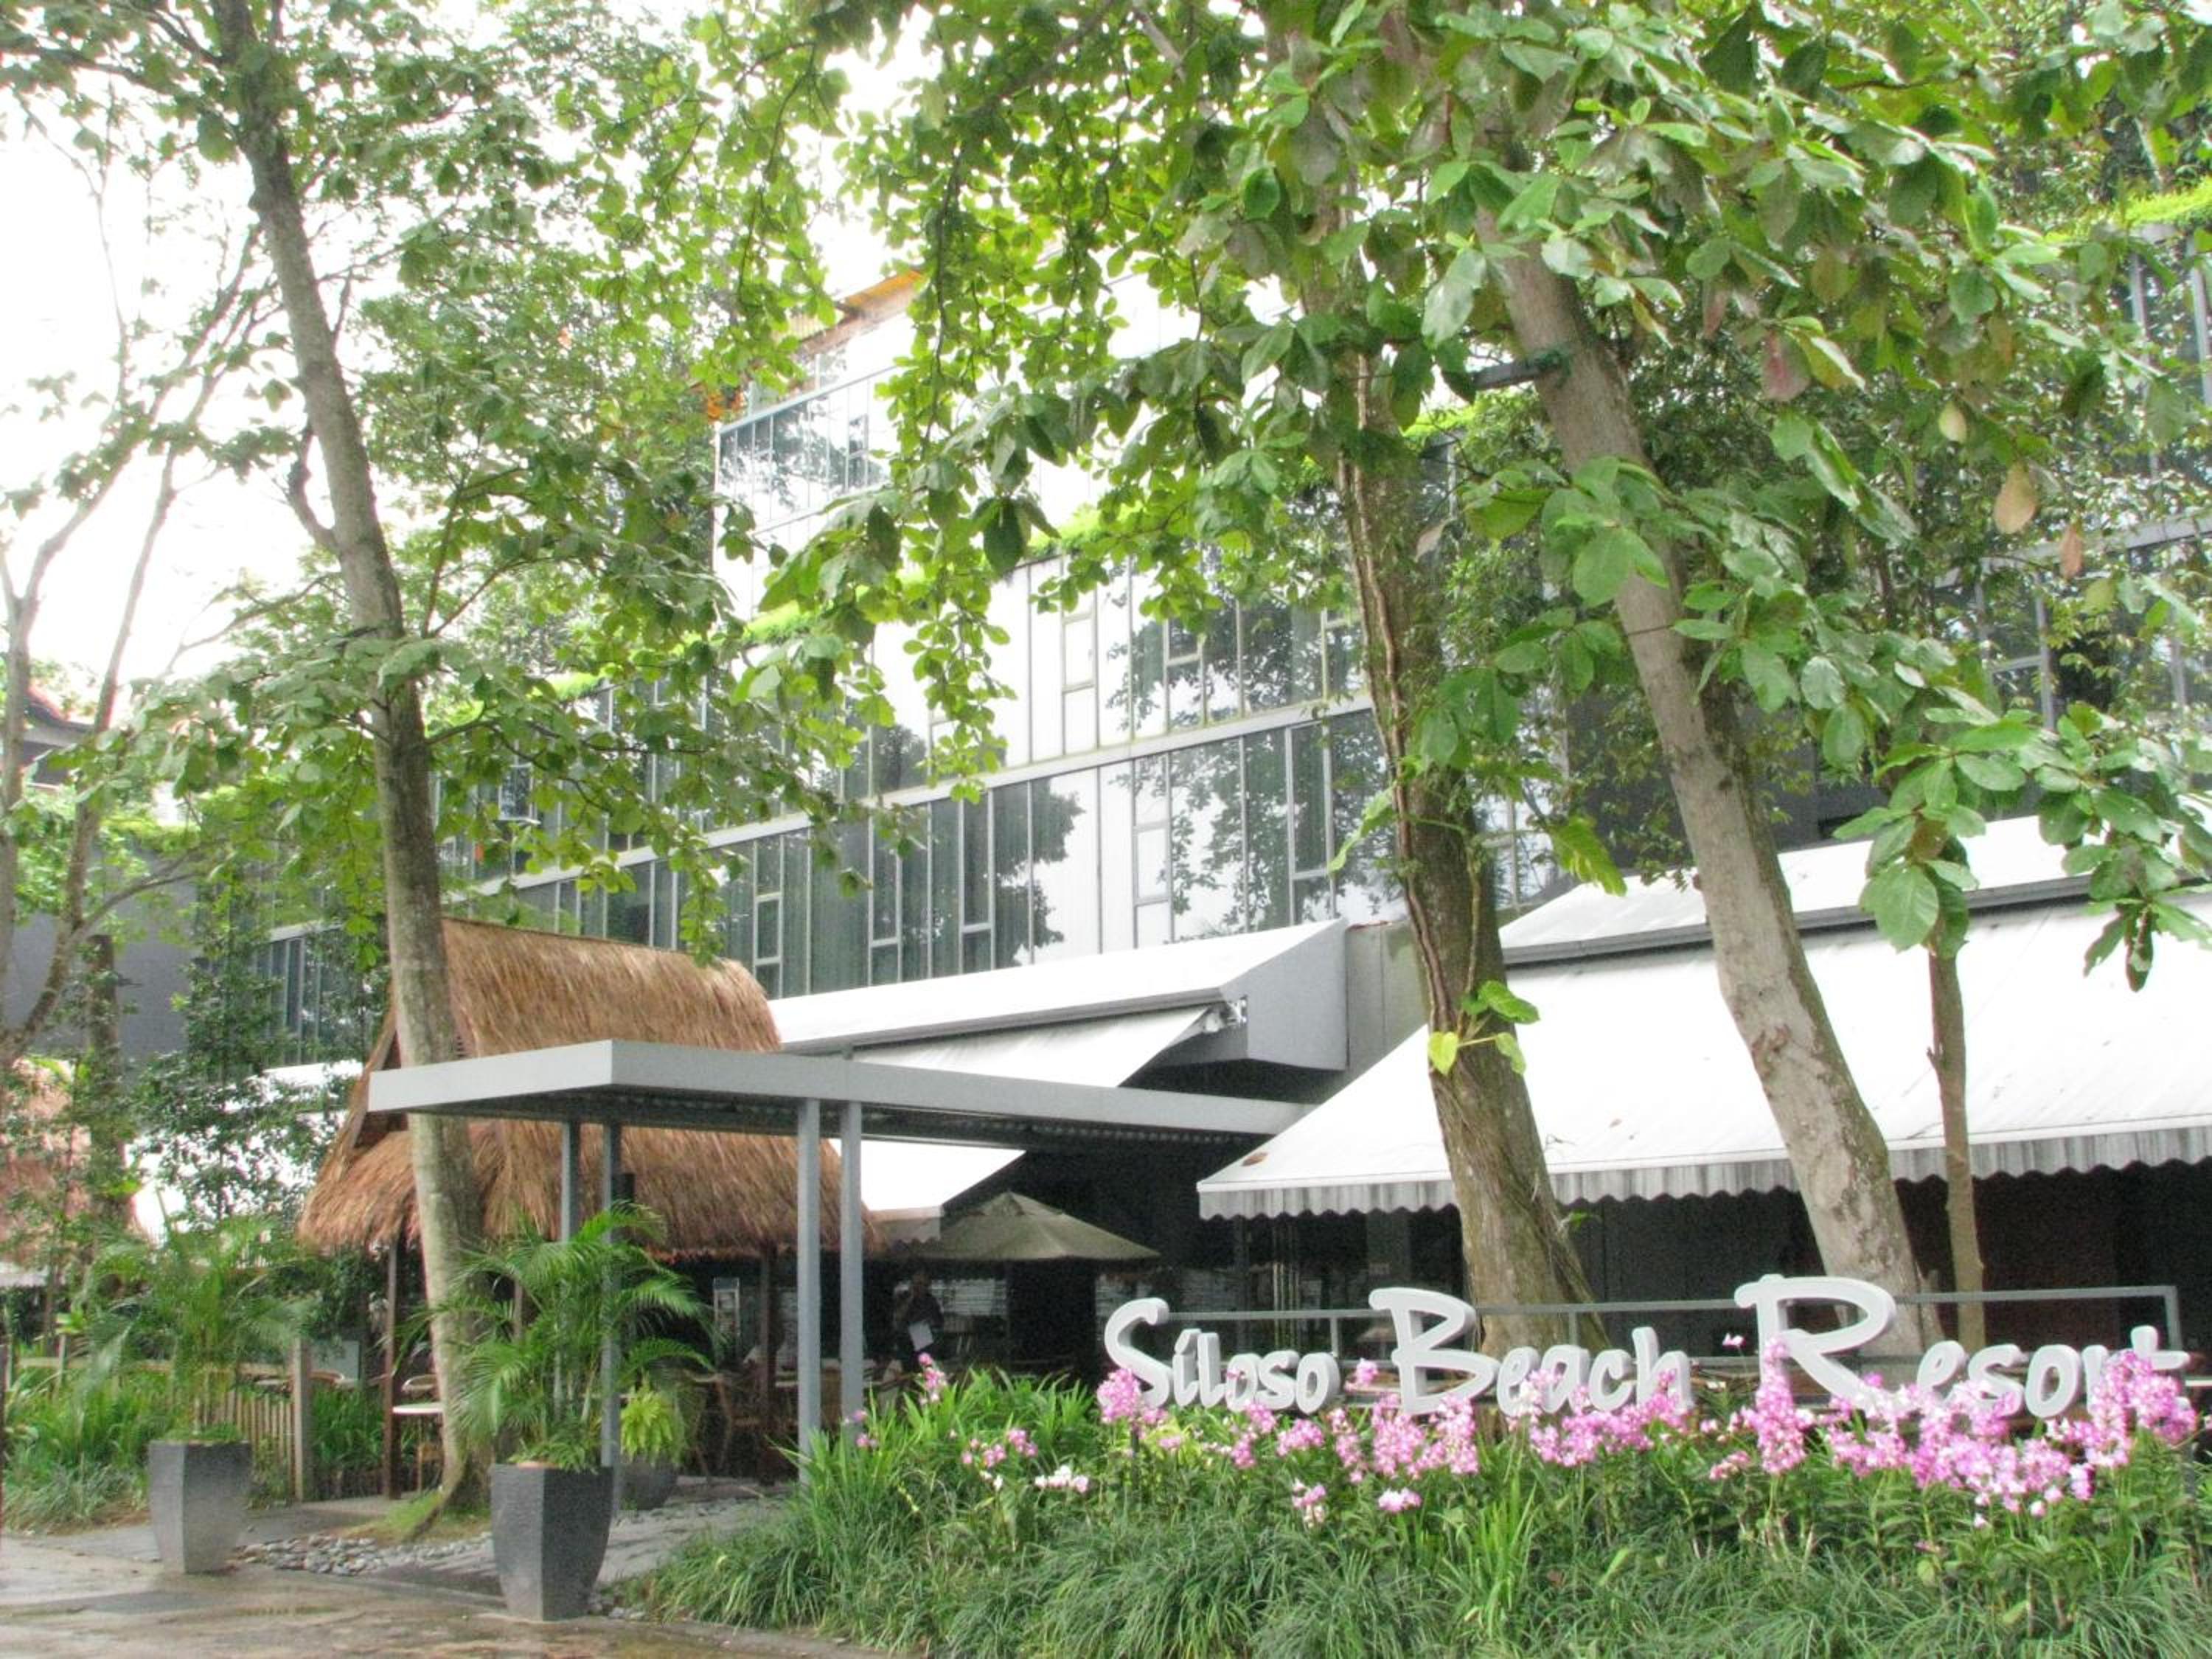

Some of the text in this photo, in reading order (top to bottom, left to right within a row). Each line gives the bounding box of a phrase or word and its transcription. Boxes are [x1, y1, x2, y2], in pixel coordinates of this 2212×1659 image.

[1105, 1273, 2191, 1419] Siloso Beach Resort
